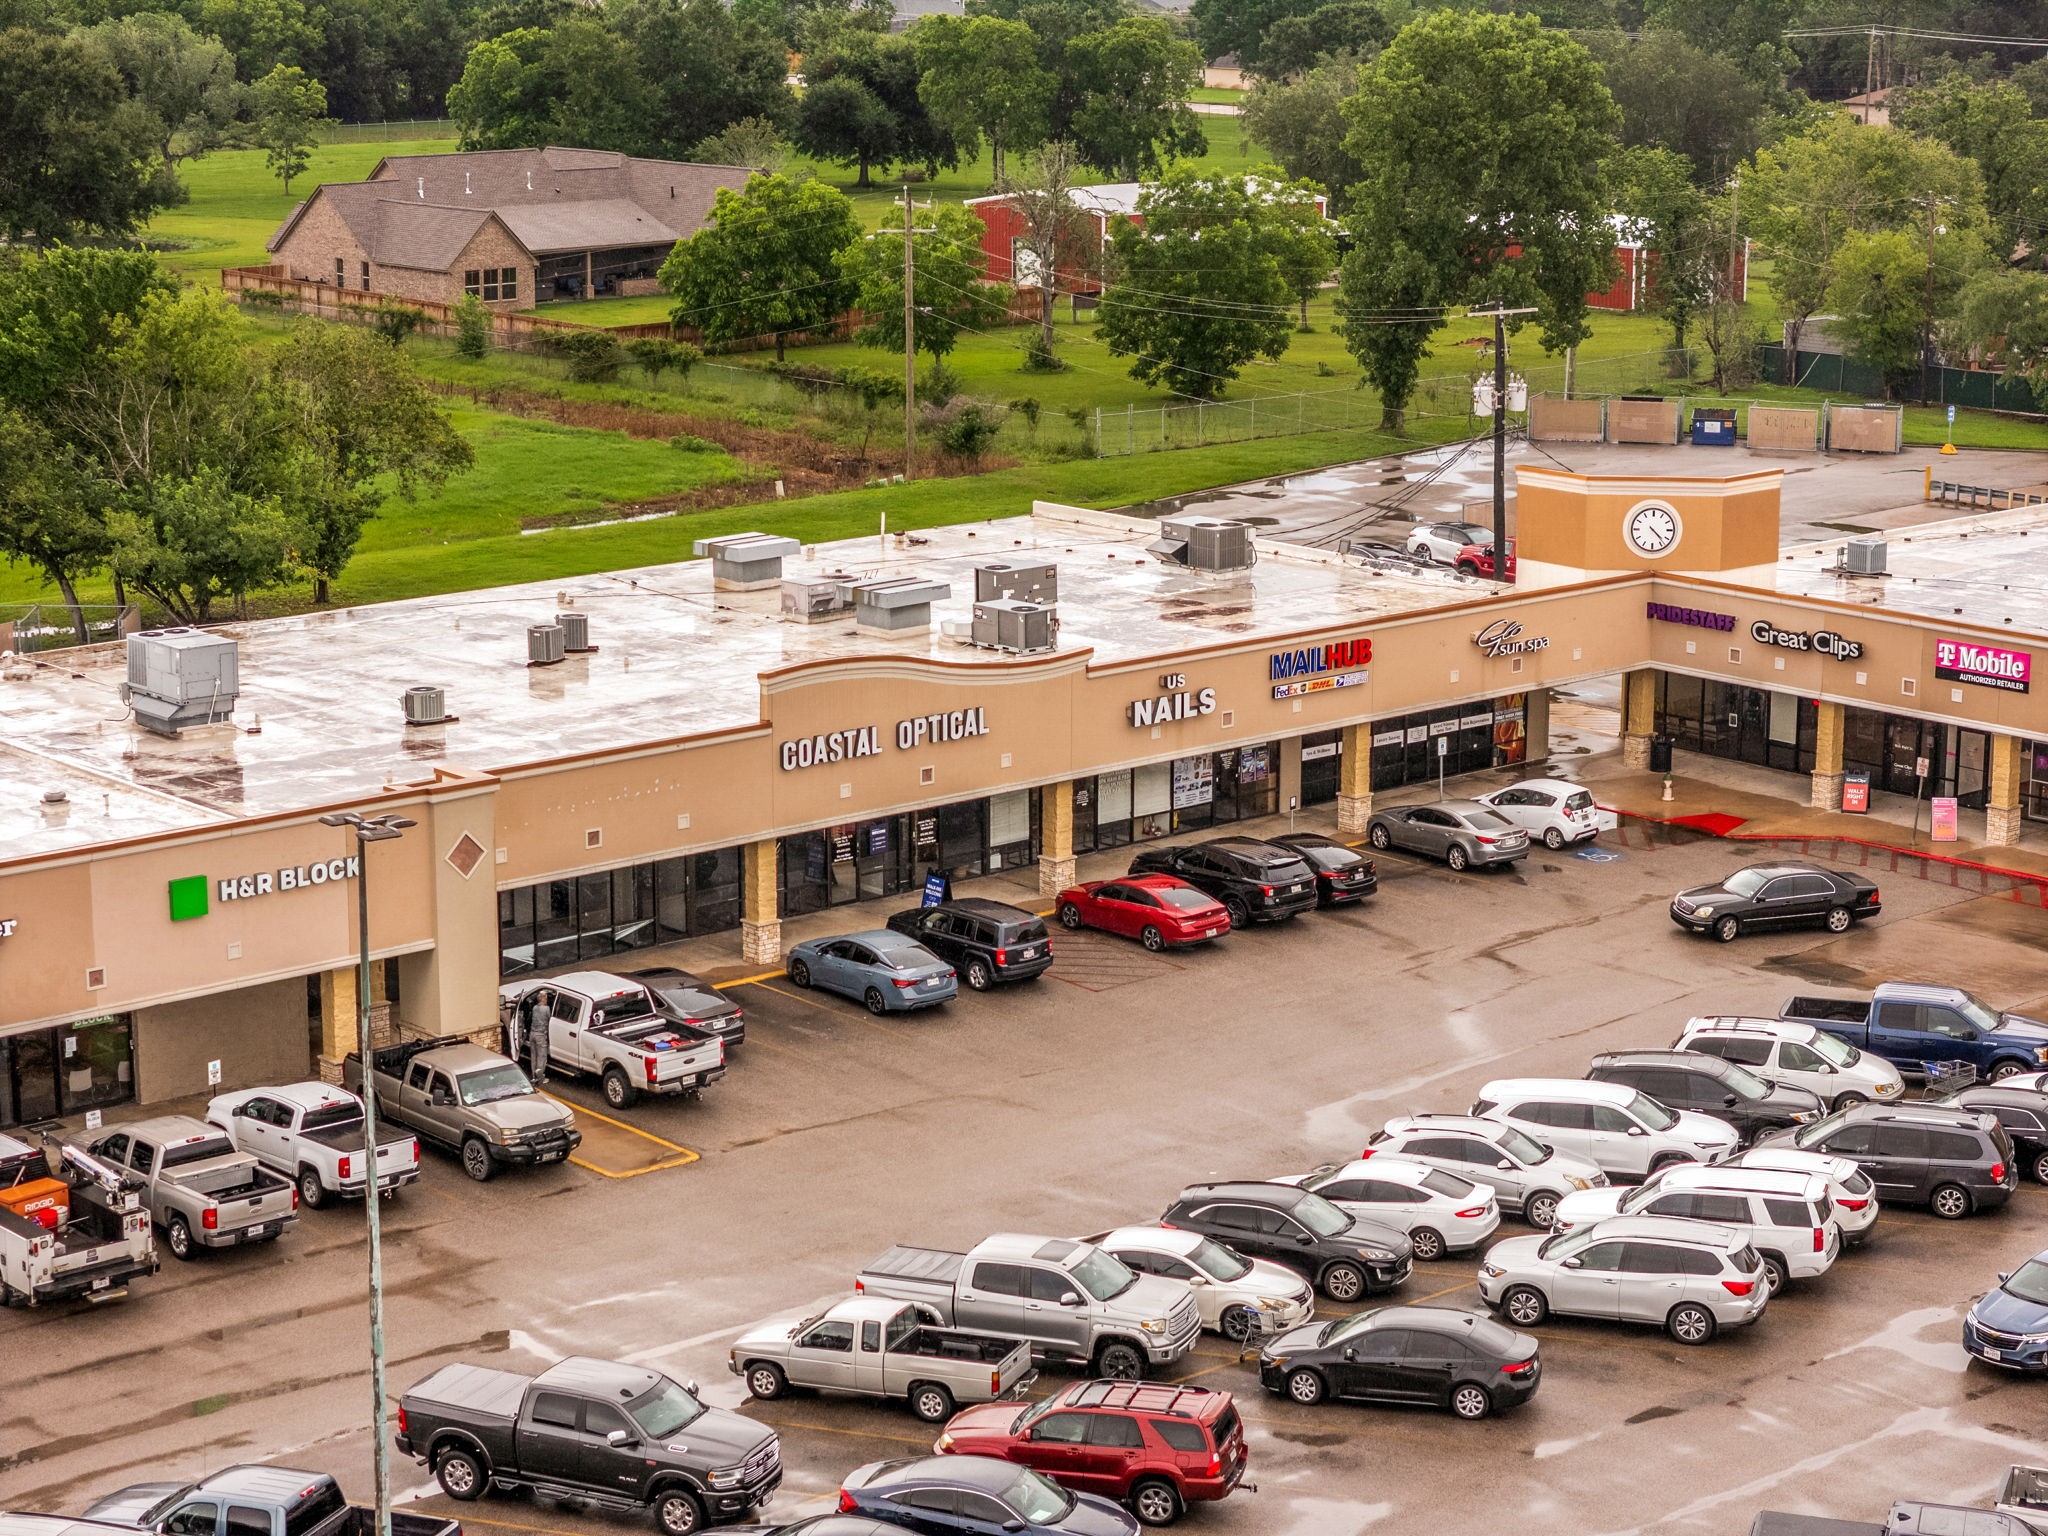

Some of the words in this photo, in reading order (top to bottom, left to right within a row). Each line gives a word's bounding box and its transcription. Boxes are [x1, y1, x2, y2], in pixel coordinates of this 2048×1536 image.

[1647, 602, 1735, 632] PRIDESTAFF
[1499, 641, 1524, 656] sun
[1526, 636, 1551, 653] spa
[1751, 620, 1811, 651] Great
[1812, 631, 1864, 661] Clips
[1958, 646, 2025, 678] Mobile
[1165, 673, 1186, 690] US
[1276, 684, 1298, 698] FedEx
[1959, 673, 1997, 686] AUTHORIZED
[1996, 679, 2024, 691] RETAILER
[1132, 686, 1216, 727] NAILS
[780, 713, 883, 771] COASTAL
[896, 706, 990, 750] OPTICAL
[218, 872, 273, 902] H&R
[278, 855, 359, 891] BLOCK
[24, 1197, 55, 1213] RIDGID
